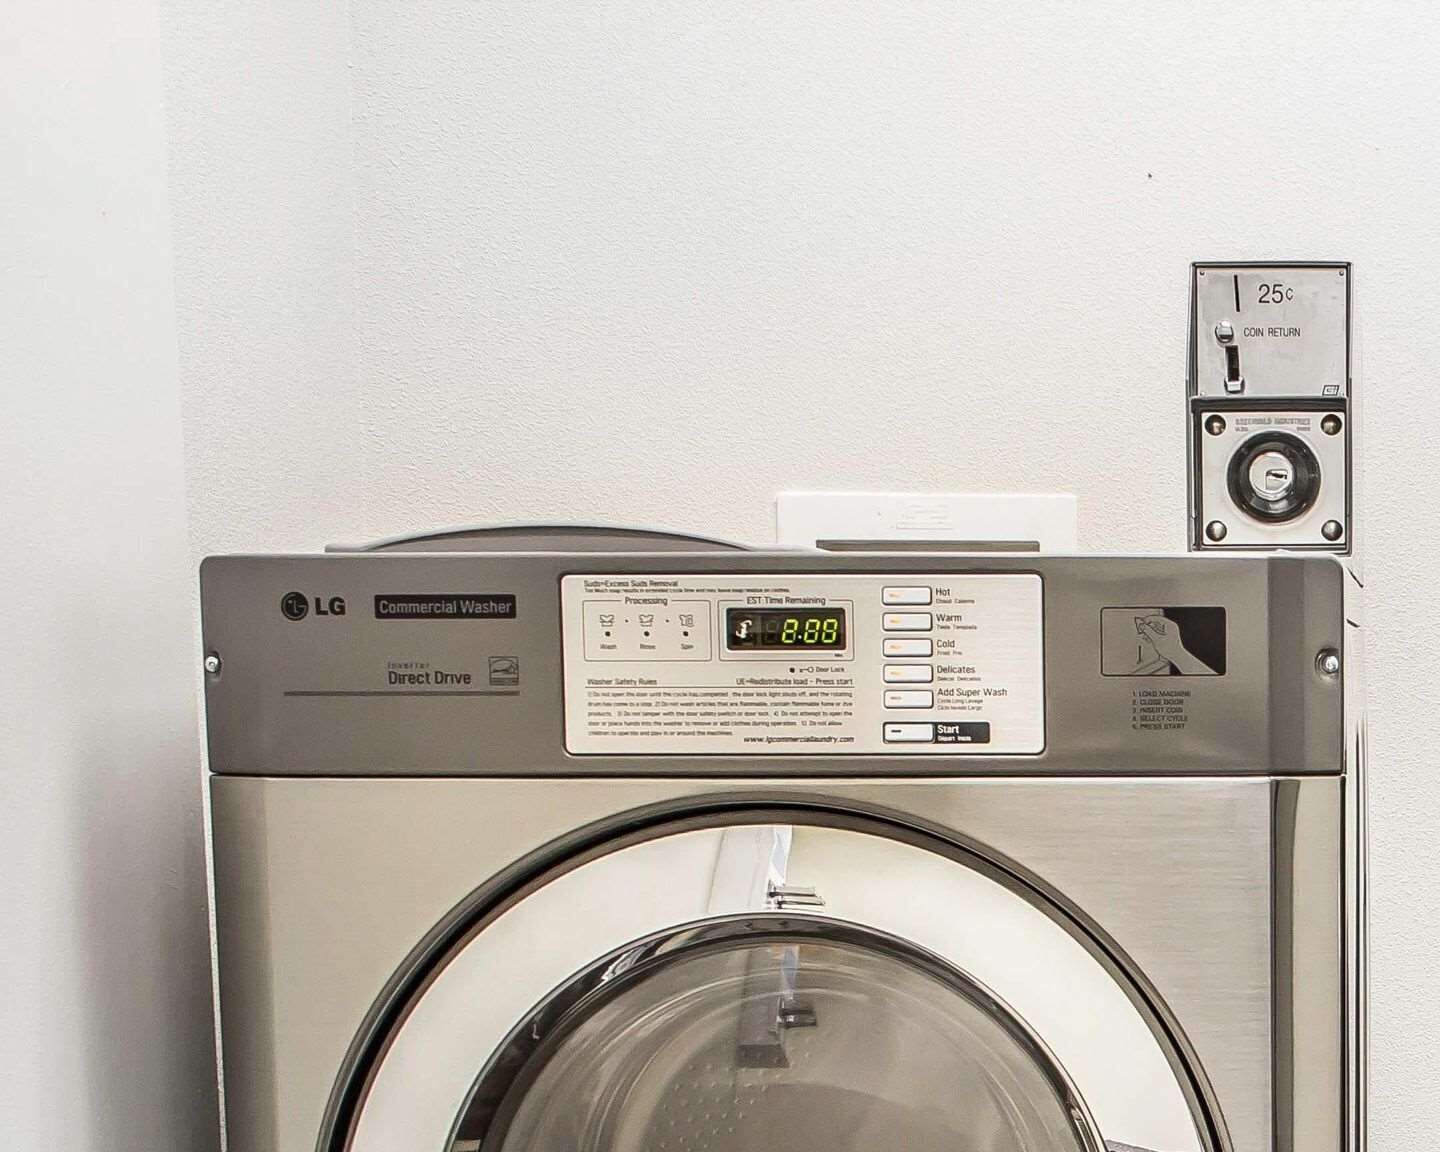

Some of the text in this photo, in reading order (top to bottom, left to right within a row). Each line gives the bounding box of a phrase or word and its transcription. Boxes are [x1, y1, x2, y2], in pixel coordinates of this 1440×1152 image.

[1258, 283, 1294, 304] 25¢
[1243, 327, 1301, 338] COIN RETURN
[649, 580, 678, 588] Removal
[935, 588, 951, 596] Hot
[314, 597, 346, 616] LG
[625, 597, 668, 606] Processing
[785, 597, 826, 606] Remaining
[379, 600, 513, 615] Commercial Washer
[388, 671, 472, 685] Direct Drive
[937, 688, 1008, 698] Add Super Wash
[937, 725, 960, 733] Start
